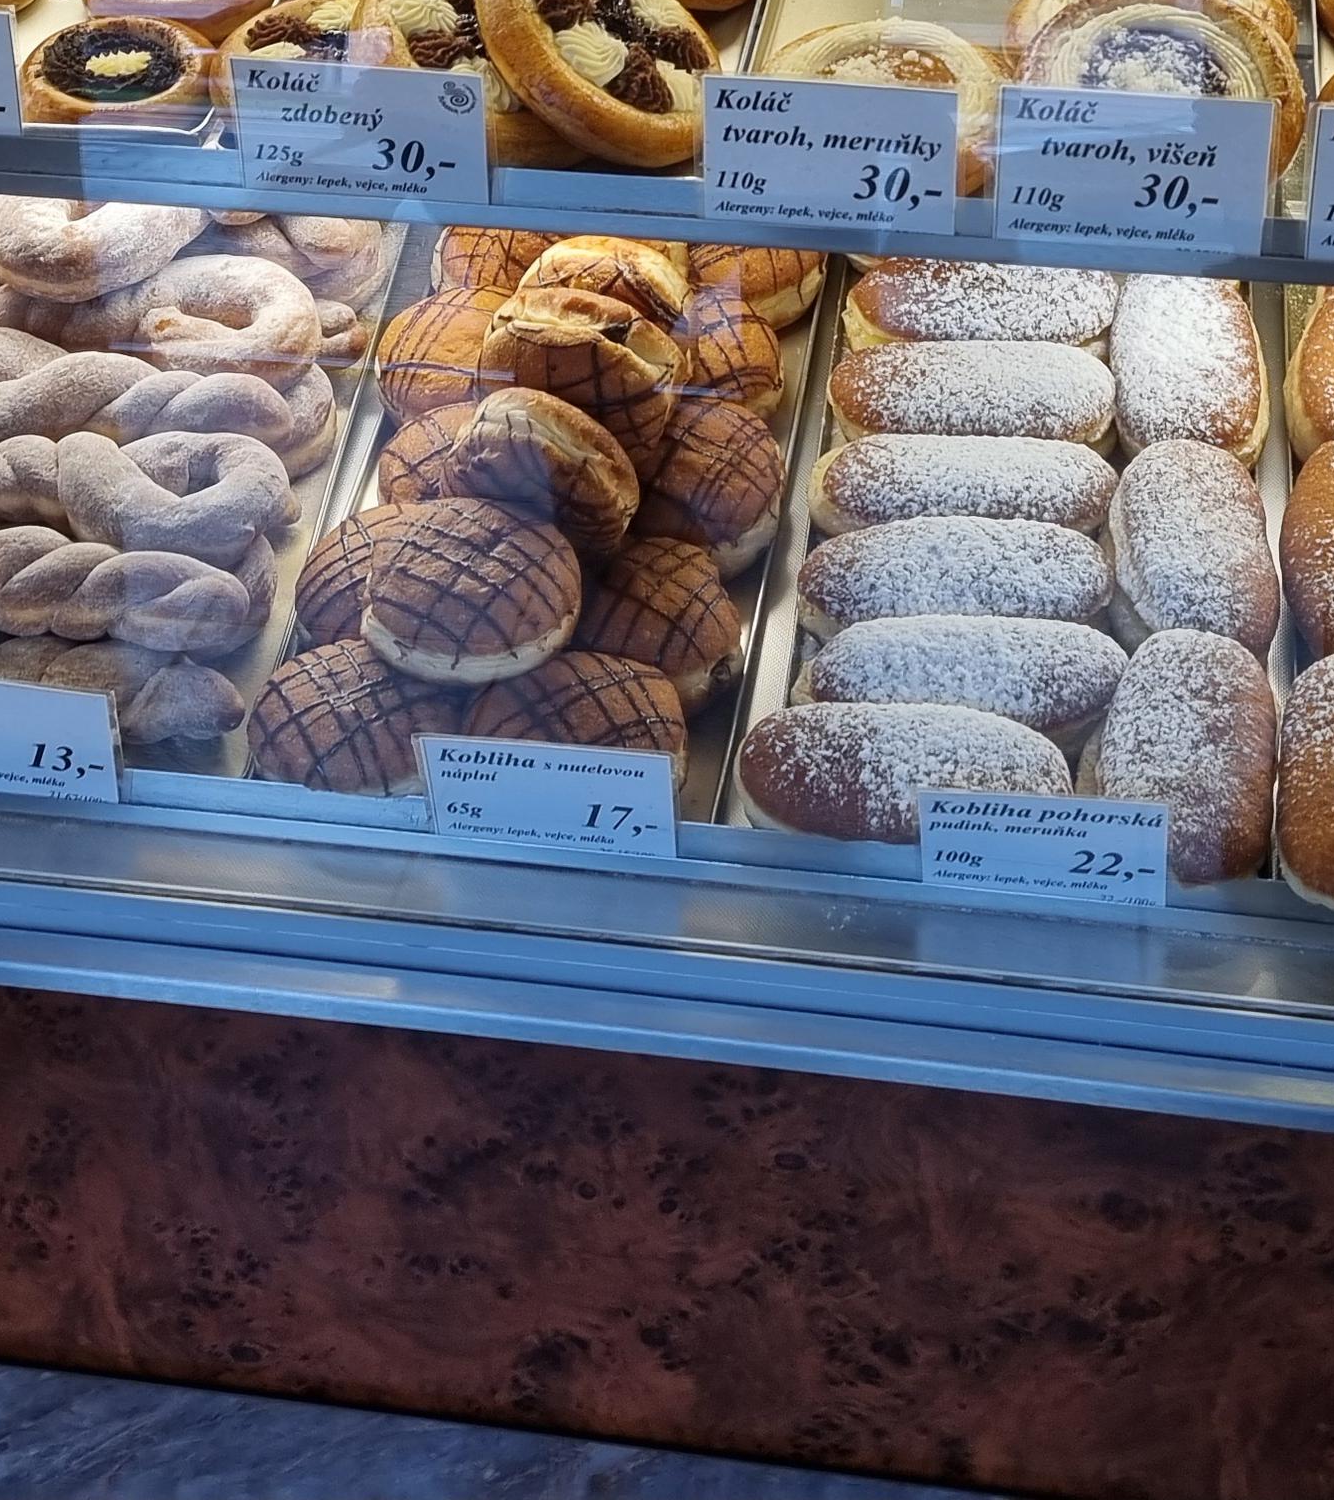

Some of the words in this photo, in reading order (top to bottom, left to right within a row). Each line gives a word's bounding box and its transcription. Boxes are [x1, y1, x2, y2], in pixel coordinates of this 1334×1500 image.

[247, 69, 320, 93] Koláč
[715, 89, 793, 113] Koláč
[1017, 97, 1098, 124] Koláč
[281, 103, 383, 131] zdobený
[722, 123, 814, 151] tvaroh,
[823, 133, 942, 162] meruňky
[1041, 136, 1136, 165] tvaroh,
[1147, 142, 1217, 168] višeň
[255, 144, 304, 167] 125g
[372, 137, 456, 182] 30,-
[256, 171, 314, 186] Alergeny:
[317, 175, 352, 189] lepek,
[355, 179, 387, 192] vejce,
[391, 182, 427, 194] mléko
[716, 170, 767, 195] 110g
[853, 165, 942, 211] 30,-
[1012, 185, 1065, 212] 110g
[1134, 173, 1219, 218] 30,-
[28, 743, 105, 779] 13,-
[439, 748, 536, 769] Kobliha
[543, 762, 551, 770] s
[557, 763, 645, 778] nutelovou
[441, 768, 498, 782] náplní
[447, 801, 482, 819] 65g
[582, 803, 658, 837] 17,-
[929, 800, 1032, 820] Kobliha
[1037, 807, 1164, 828] pohorská
[928, 820, 999, 833] pudink,
[1004, 824, 1087, 839] meruňka
[934, 849, 984, 867] 100g
[1069, 850, 1156, 882] 22,-
